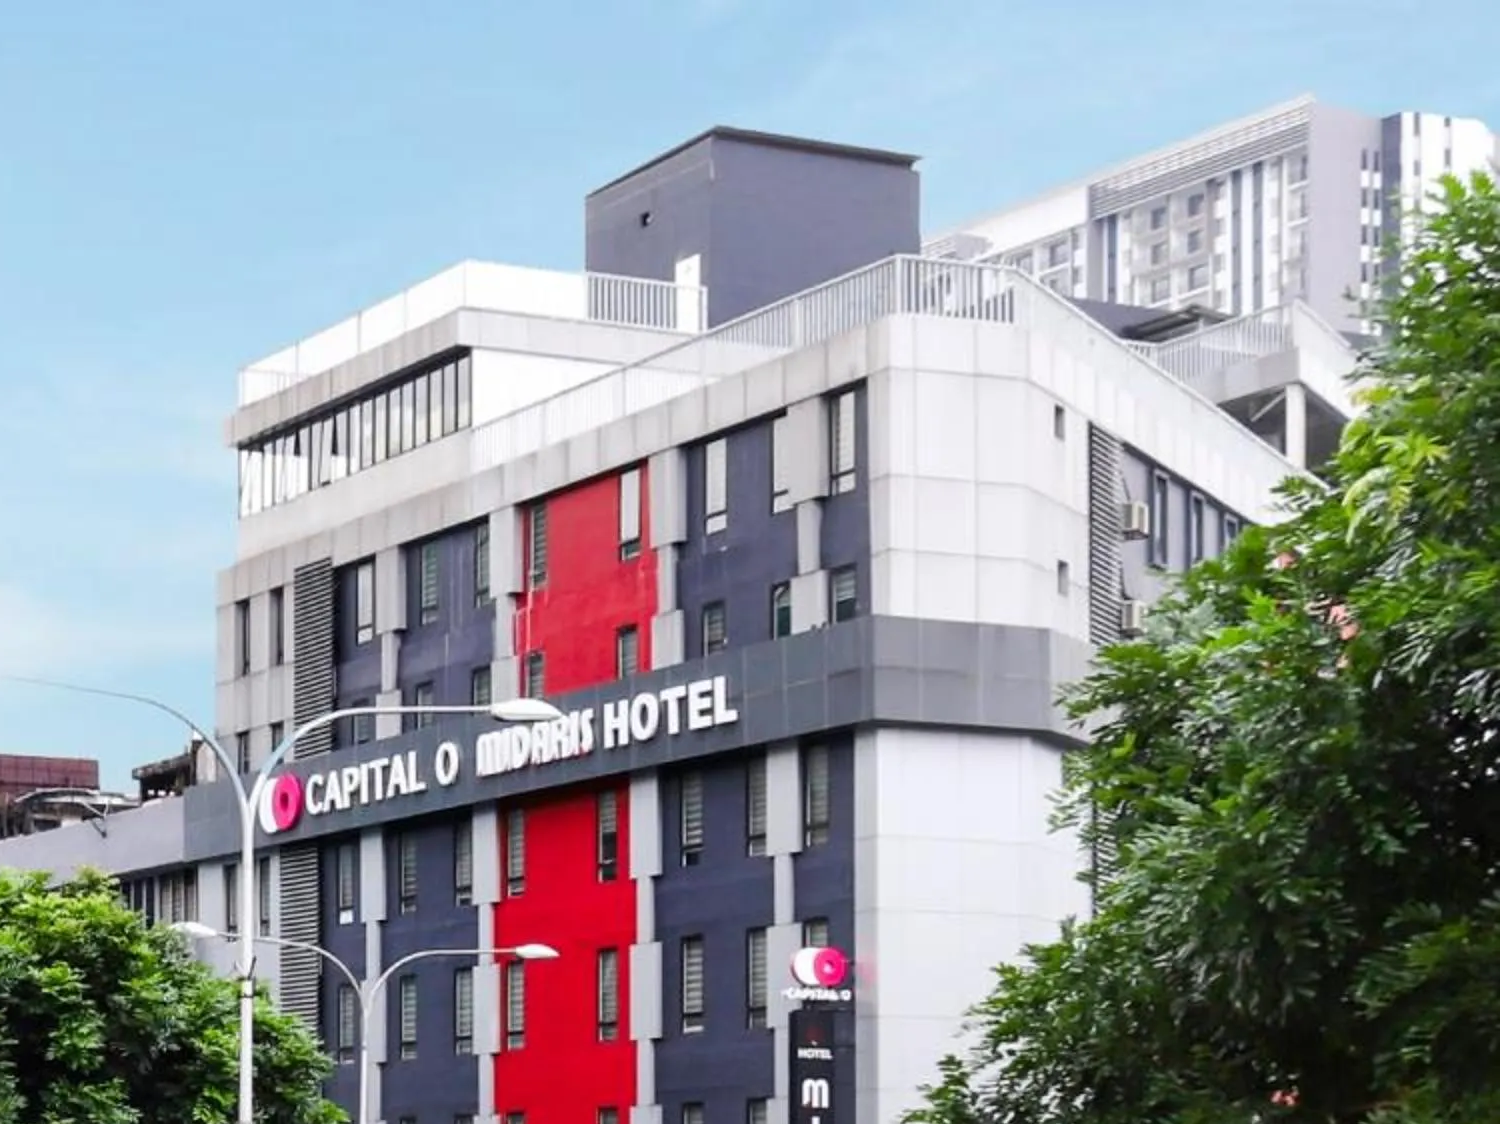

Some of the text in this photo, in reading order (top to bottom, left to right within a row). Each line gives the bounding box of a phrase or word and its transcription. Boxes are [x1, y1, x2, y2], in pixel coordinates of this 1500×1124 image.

[305, 675, 739, 816] CAPITAL O MIDARIS HOTEL
[797, 1047, 833, 1060] HOTEL
